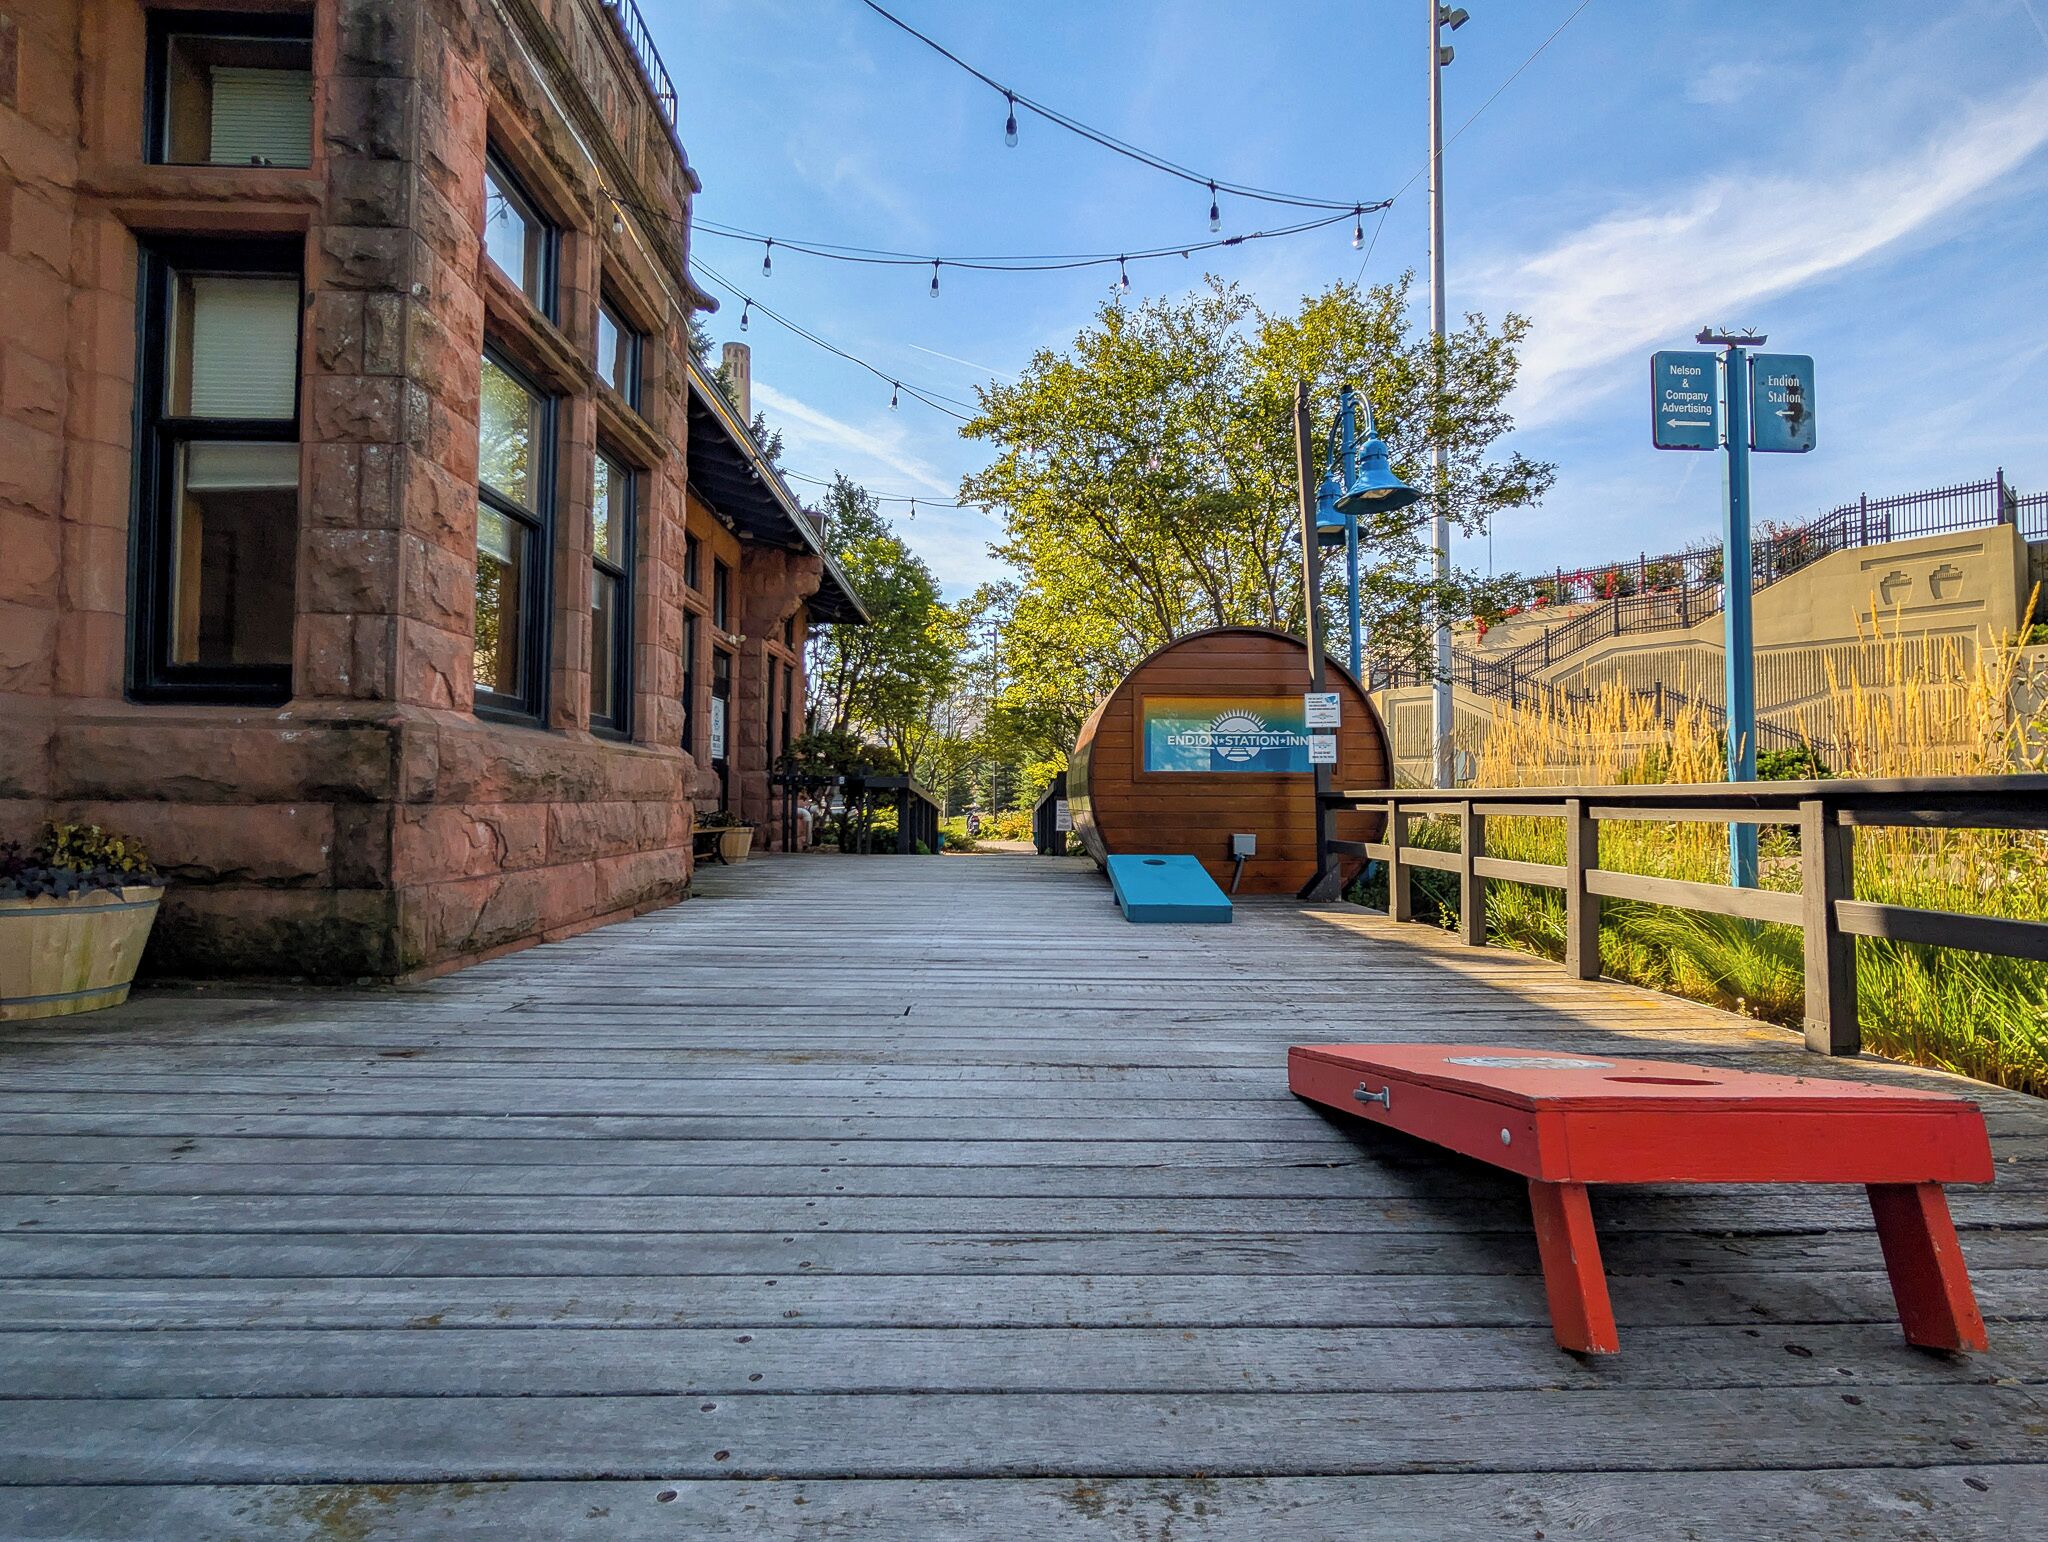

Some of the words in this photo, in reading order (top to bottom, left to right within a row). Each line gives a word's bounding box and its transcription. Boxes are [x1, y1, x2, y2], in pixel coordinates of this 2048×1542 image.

[1670, 365, 1701, 375] Nelson
[1682, 378, 1689, 388] &
[1768, 375, 1800, 387] Endion
[1666, 390, 1709, 402] Company
[1768, 391, 1801, 403] Station
[1662, 403, 1712, 415] Advertising
[1167, 735, 1219, 746] ENDION
[1225, 735, 1280, 746] STATION
[1286, 735, 1309, 746] INN
